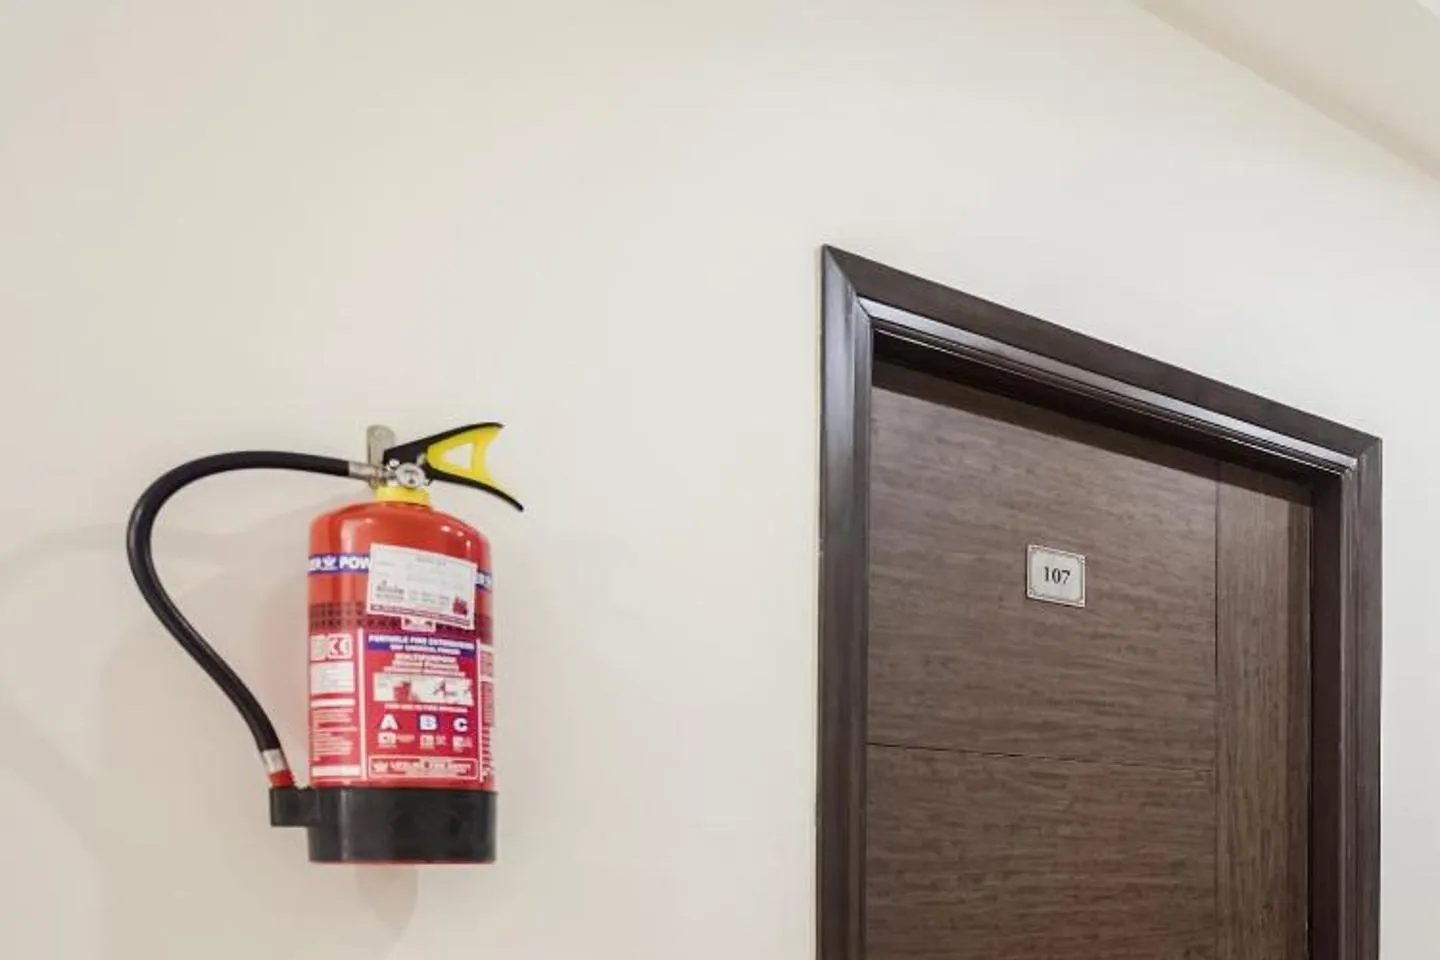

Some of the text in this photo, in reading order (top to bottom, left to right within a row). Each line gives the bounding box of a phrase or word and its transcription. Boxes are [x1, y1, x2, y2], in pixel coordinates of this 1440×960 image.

[1044, 566, 1070, 584] 107
[380, 713, 468, 732] A B C
